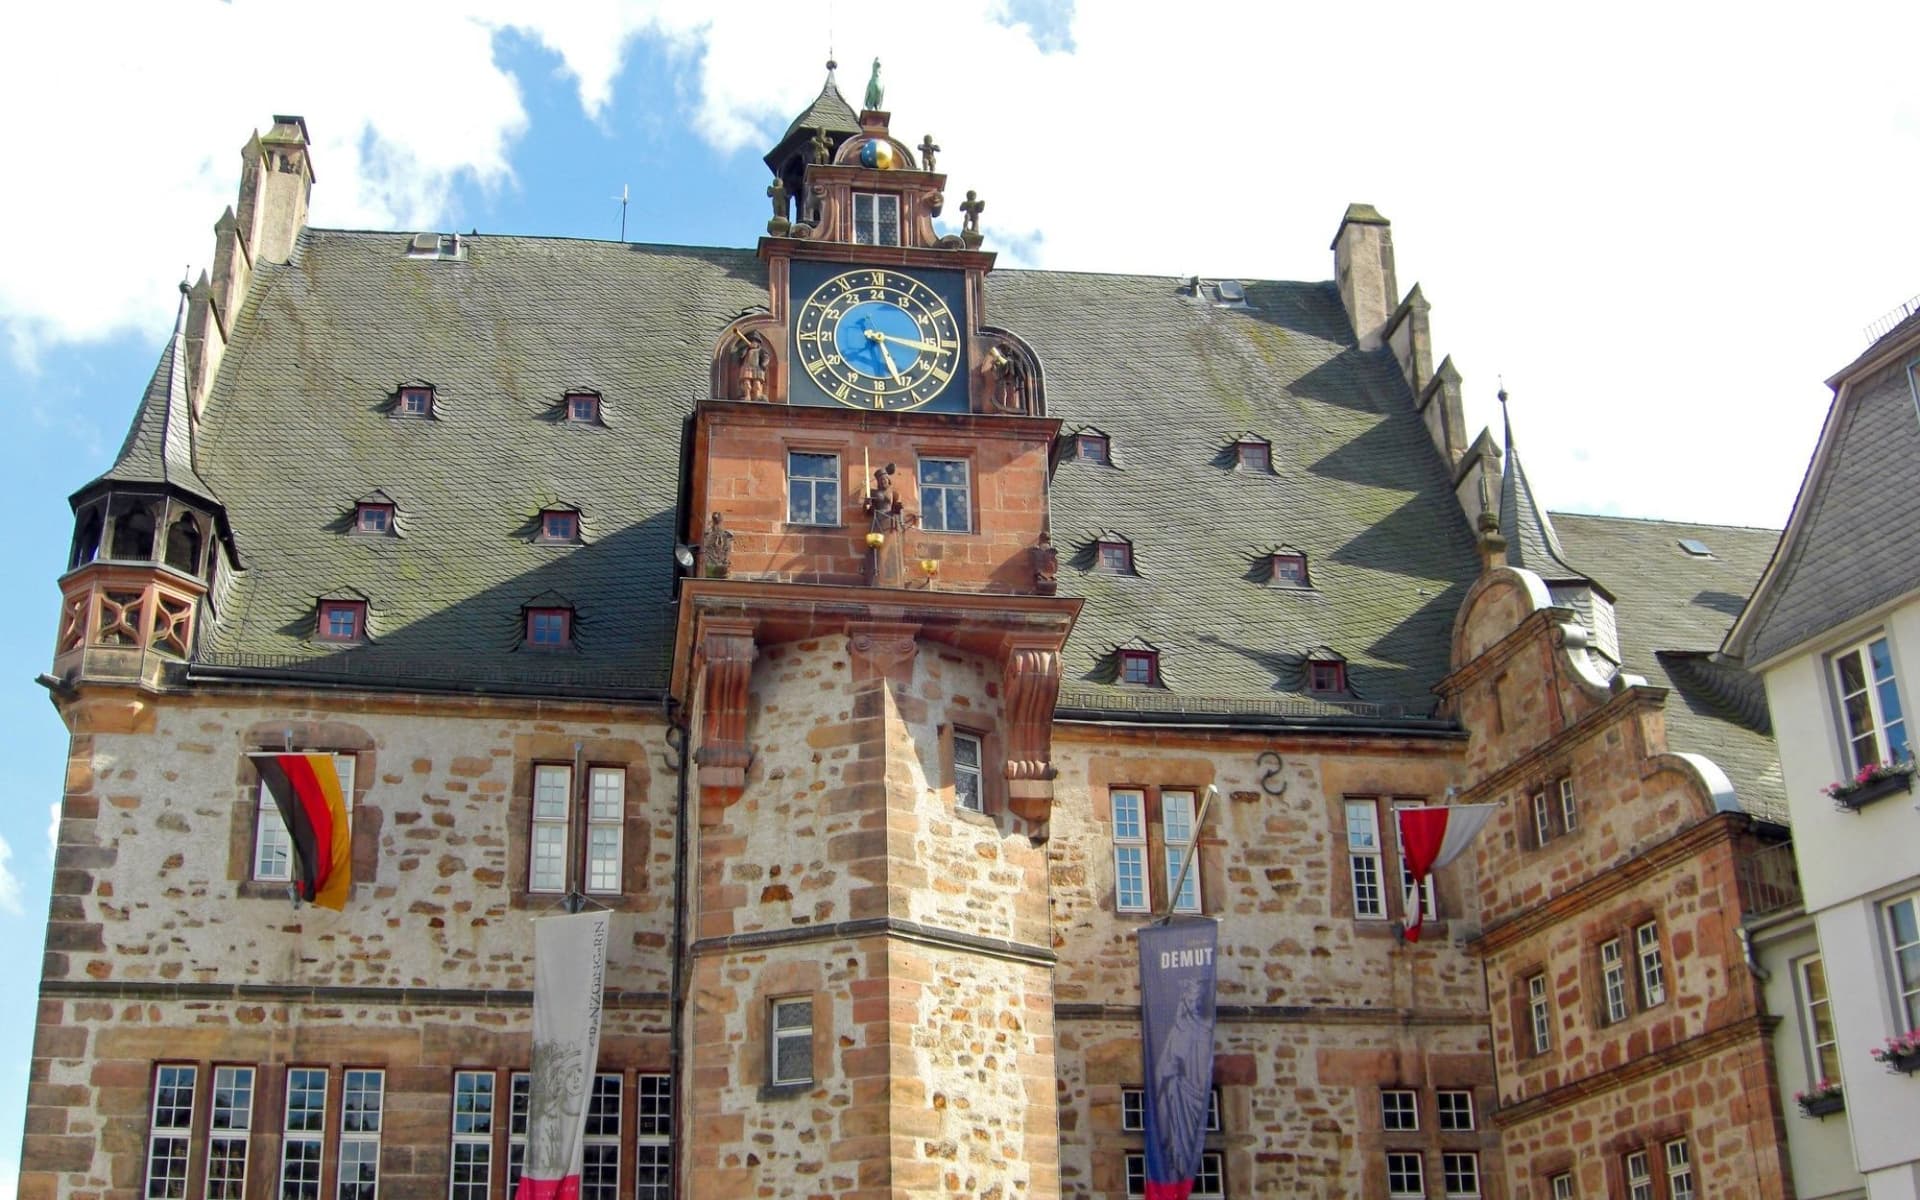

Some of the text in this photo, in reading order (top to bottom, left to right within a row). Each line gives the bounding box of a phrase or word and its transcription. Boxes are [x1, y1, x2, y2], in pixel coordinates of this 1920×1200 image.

[836, 277, 850, 292] XI
[871, 272, 884, 286] XII
[846, 294, 860, 305] 23
[870, 289, 885, 300] 24
[809, 299, 826, 312] X
[898, 297, 910, 308] 13
[827, 309, 840, 319] 22
[932, 308, 947, 318] II
[918, 314, 929, 325] 14
[821, 333, 832, 342] 21
[925, 337, 937, 347] 15
[827, 355, 840, 365] 20
[919, 360, 930, 370] 16
[847, 373, 858, 383] 19
[901, 376, 912, 387] 17
[873, 380, 885, 391] 18
[1161, 948, 1213, 969] DEMUT
